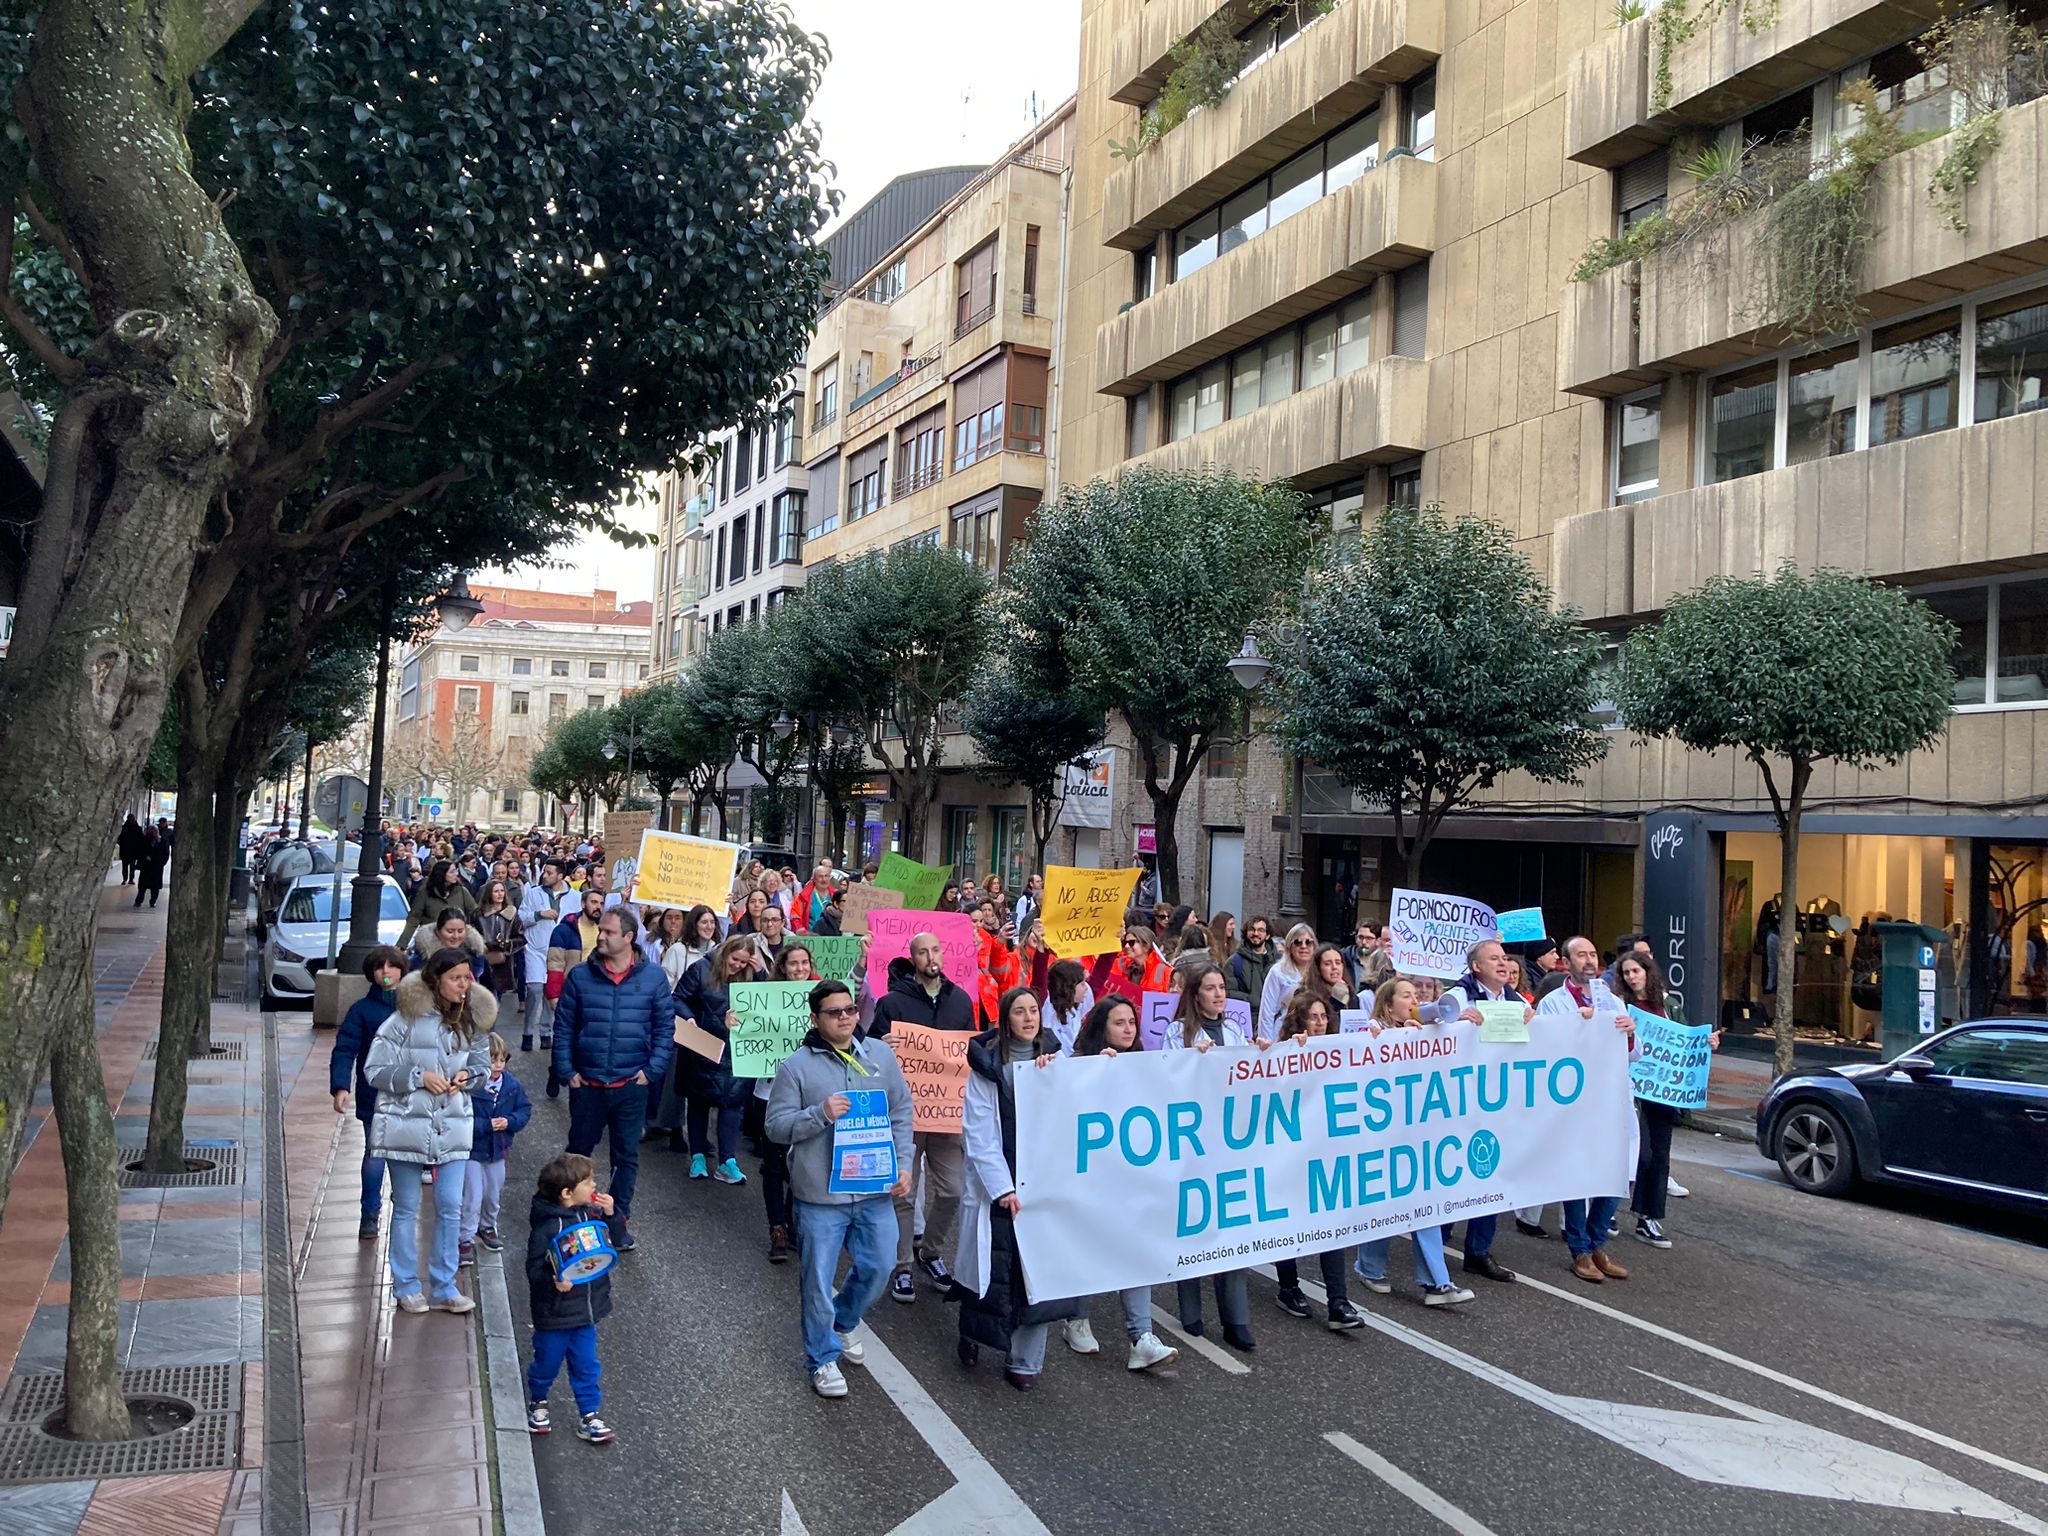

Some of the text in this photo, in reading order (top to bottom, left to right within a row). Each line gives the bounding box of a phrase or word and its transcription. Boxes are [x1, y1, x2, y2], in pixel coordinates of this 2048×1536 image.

[660, 850, 673, 861] NO
[659, 862, 673, 873] NO
[657, 873, 671, 884] NO
[1058, 886, 1121, 905] NO ABUSES
[1067, 907, 1083, 920] DE
[1056, 922, 1106, 943] VOCACIÓN
[1392, 919, 1419, 944] STOP
[821, 940, 839, 955] NO
[1420, 933, 1469, 956] VOSOTR
[1668, 914, 1687, 1010] UORE
[1923, 946, 1934, 966] P
[955, 963, 973, 977] EN
[735, 990, 811, 1014] SIN DOR
[736, 1015, 814, 1034] Y SIN PAR
[898, 1029, 968, 1058] HAGO HOR
[1642, 1021, 1709, 1051] NUESTRO
[735, 1038, 774, 1057] ERROR
[1642, 1042, 1708, 1068] OCACIÓN
[1228, 1035, 1457, 1085] ¡SALVEMOS LA SANIDAD!
[954, 1063, 965, 1078] Y
[914, 1104, 963, 1119] VOCACIO
[1076, 1057, 1585, 1174] POR UN ESTATUTO
[836, 1114, 889, 1130] HUELGA MÉDICA
[1176, 1166, 1289, 1238] DEL
[1176, 1192, 1504, 1267] Asociación de Médicos Unidos por sus Derechos, MUD @mudmedicos
